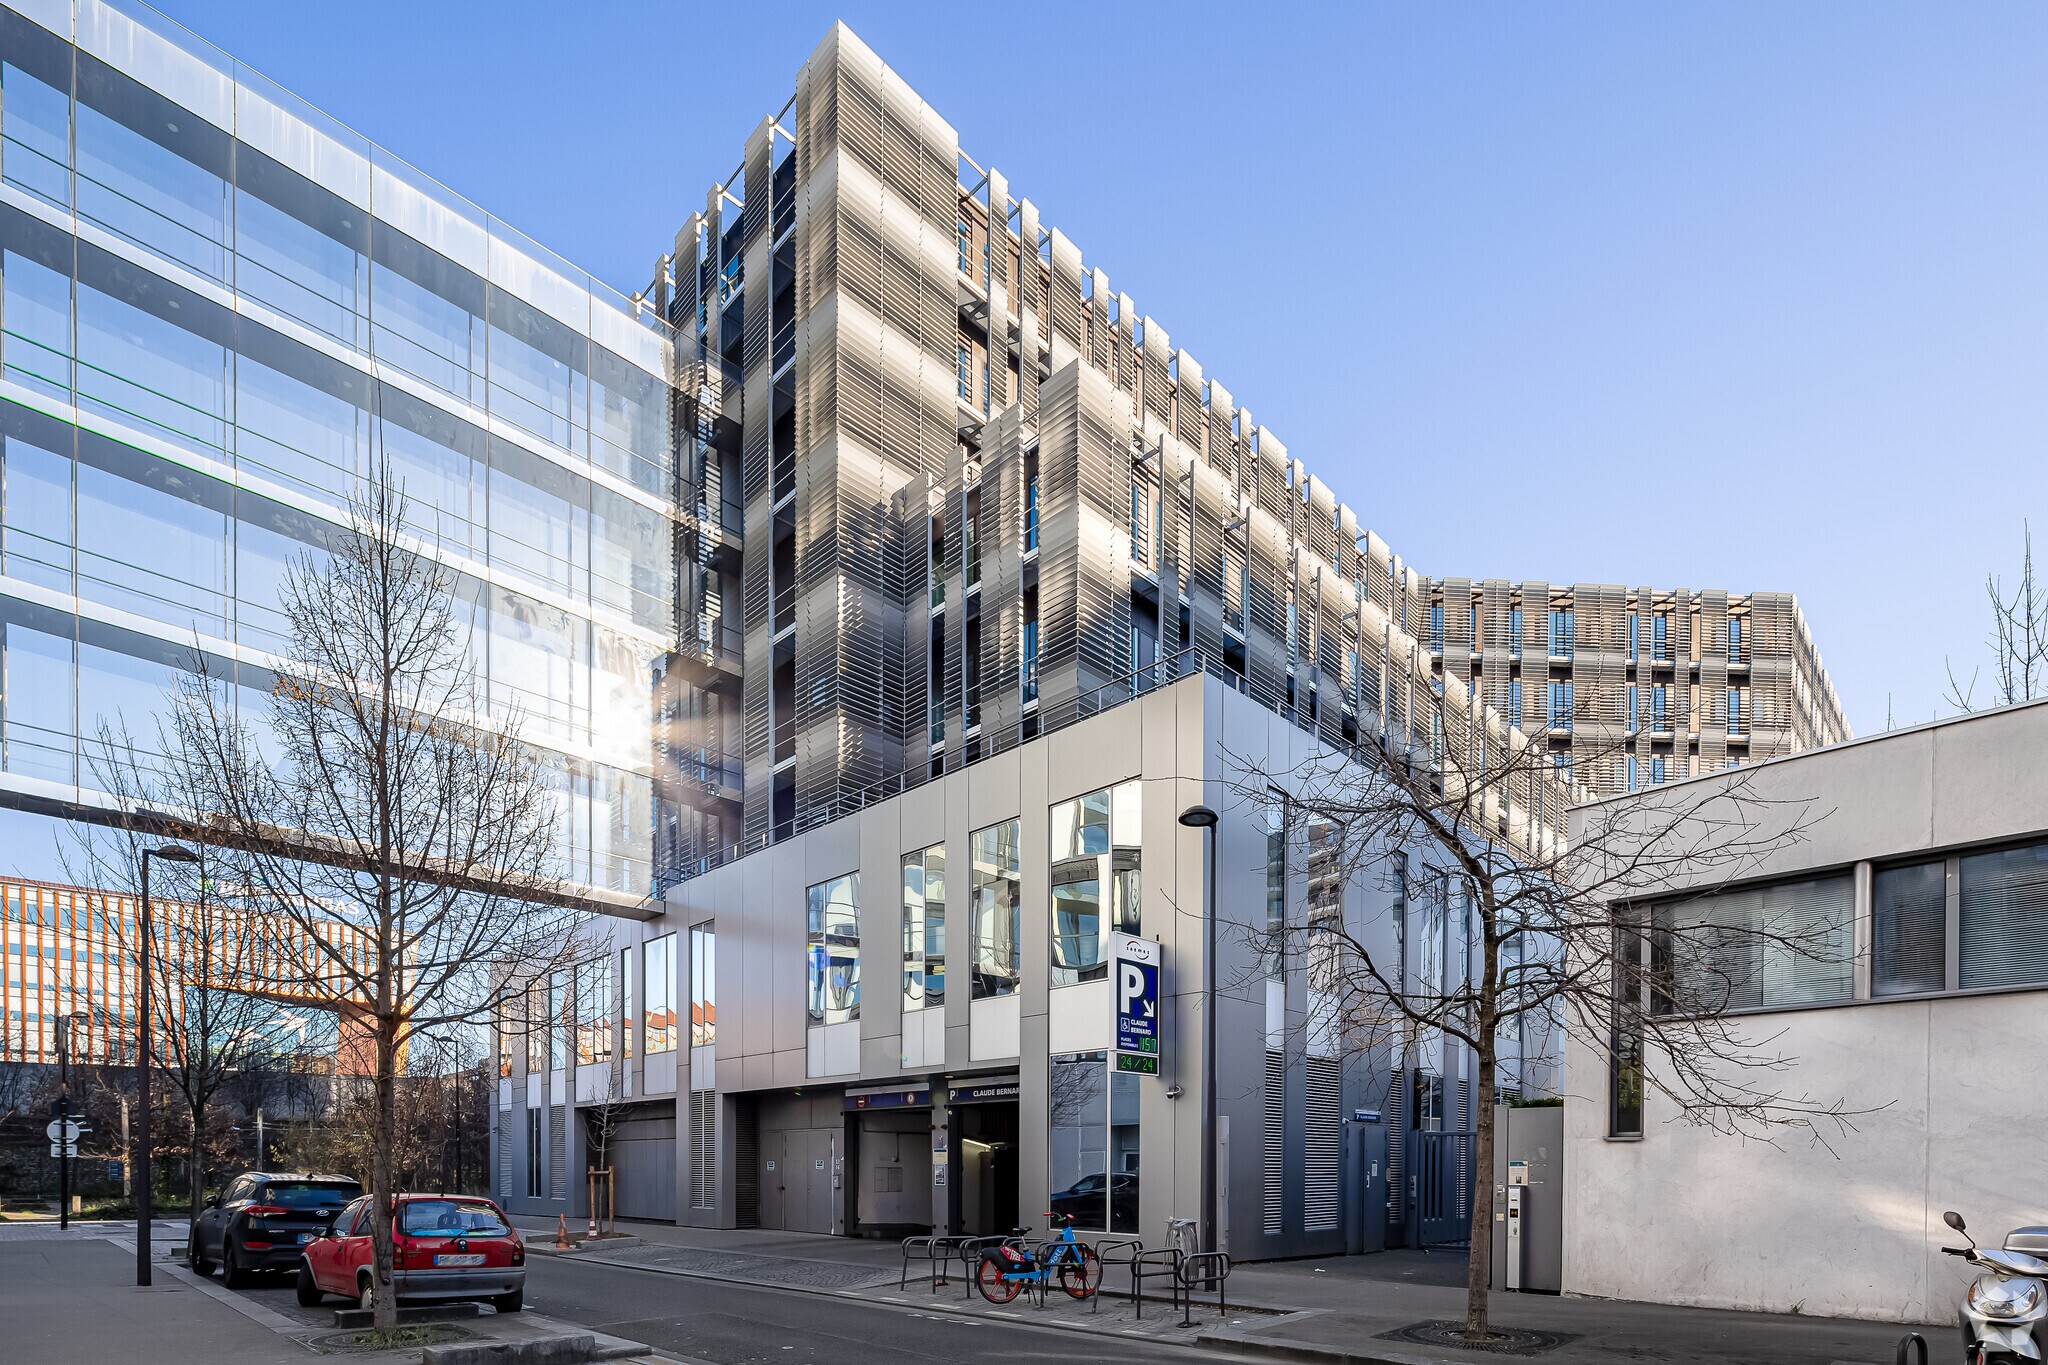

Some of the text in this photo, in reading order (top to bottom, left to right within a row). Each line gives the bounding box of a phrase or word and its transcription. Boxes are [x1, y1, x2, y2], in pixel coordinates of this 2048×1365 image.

[1120, 963, 1145, 1013] P
[1130, 1019, 1148, 1027] CLAUDE
[1130, 1027, 1152, 1035] BERNARD
[1141, 1037, 1157, 1052] 157
[949, 1089, 956, 1100] P
[973, 1088, 995, 1097] CLAUDE
